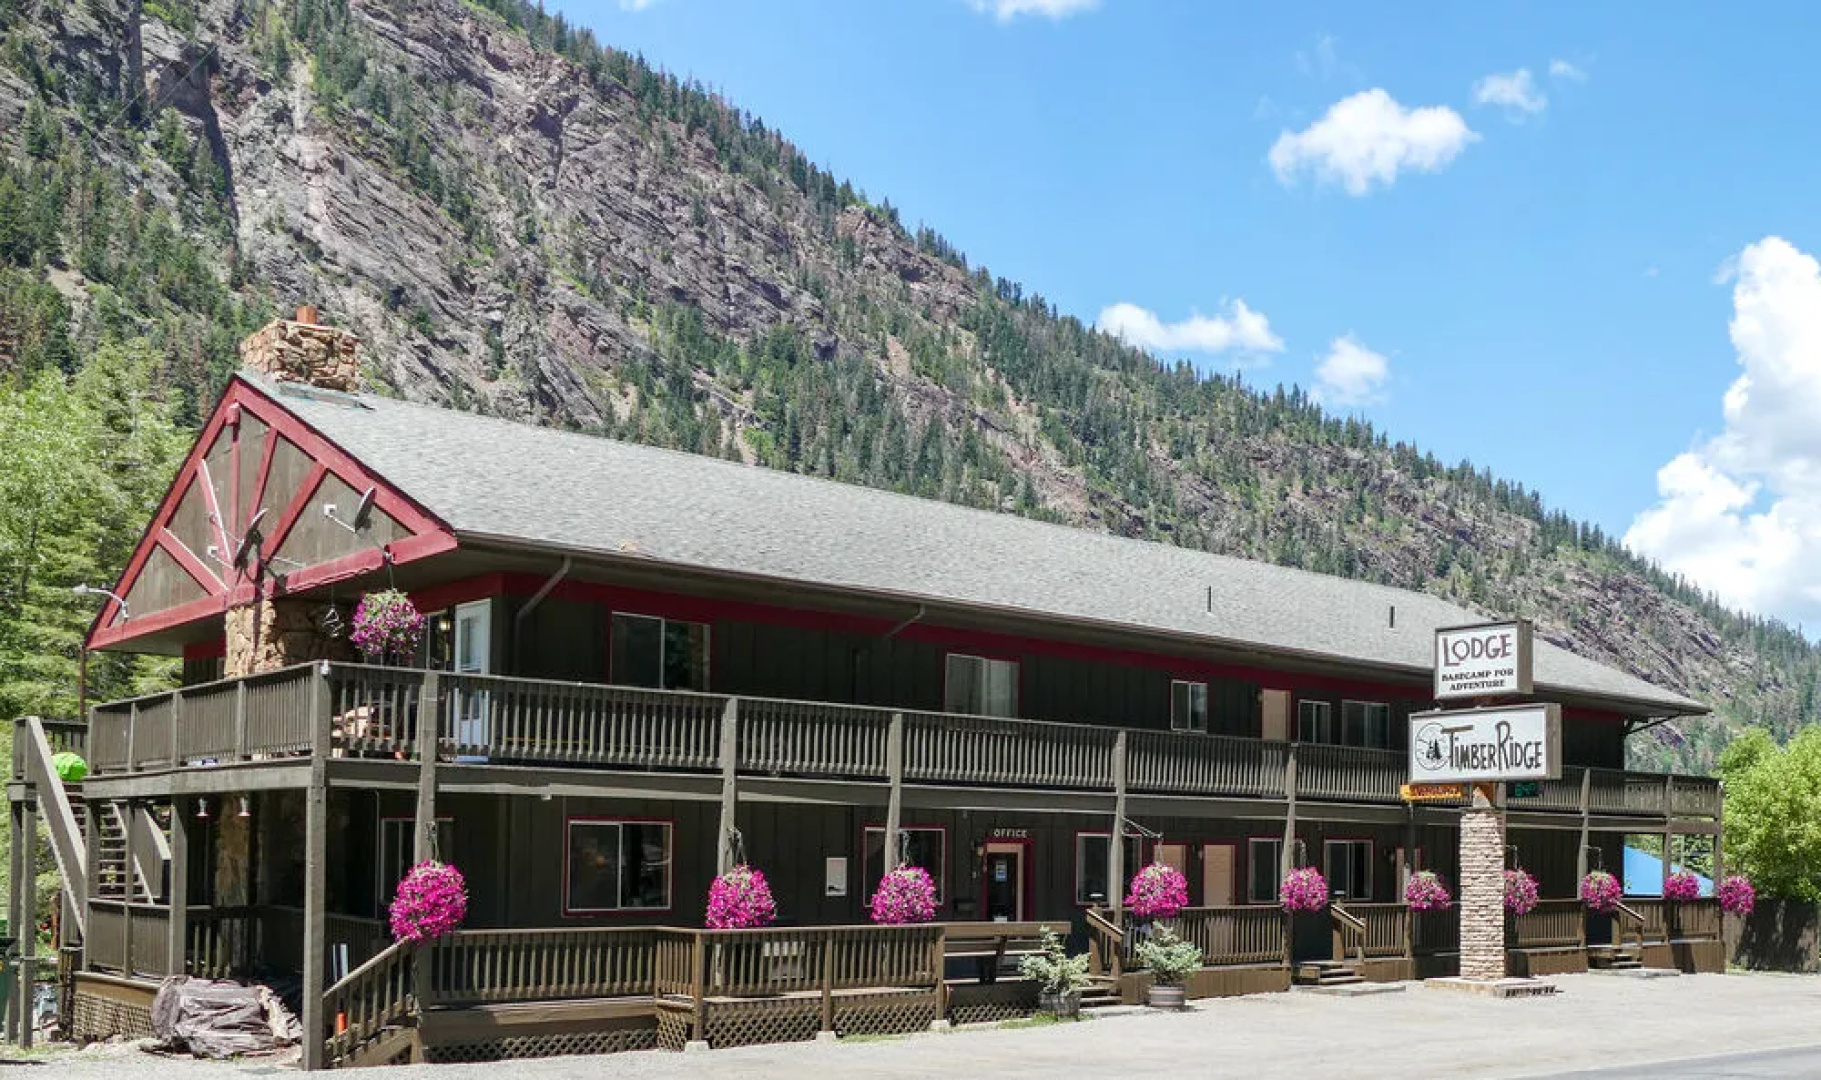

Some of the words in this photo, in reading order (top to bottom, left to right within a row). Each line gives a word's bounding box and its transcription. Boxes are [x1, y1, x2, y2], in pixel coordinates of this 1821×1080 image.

[1442, 633, 1512, 667] LODGE
[1441, 669, 1492, 682] BASECAMP
[1494, 667, 1514, 678] FOR
[1449, 679, 1506, 691] ADVENTURE
[993, 828, 1028, 838] OFFICE
